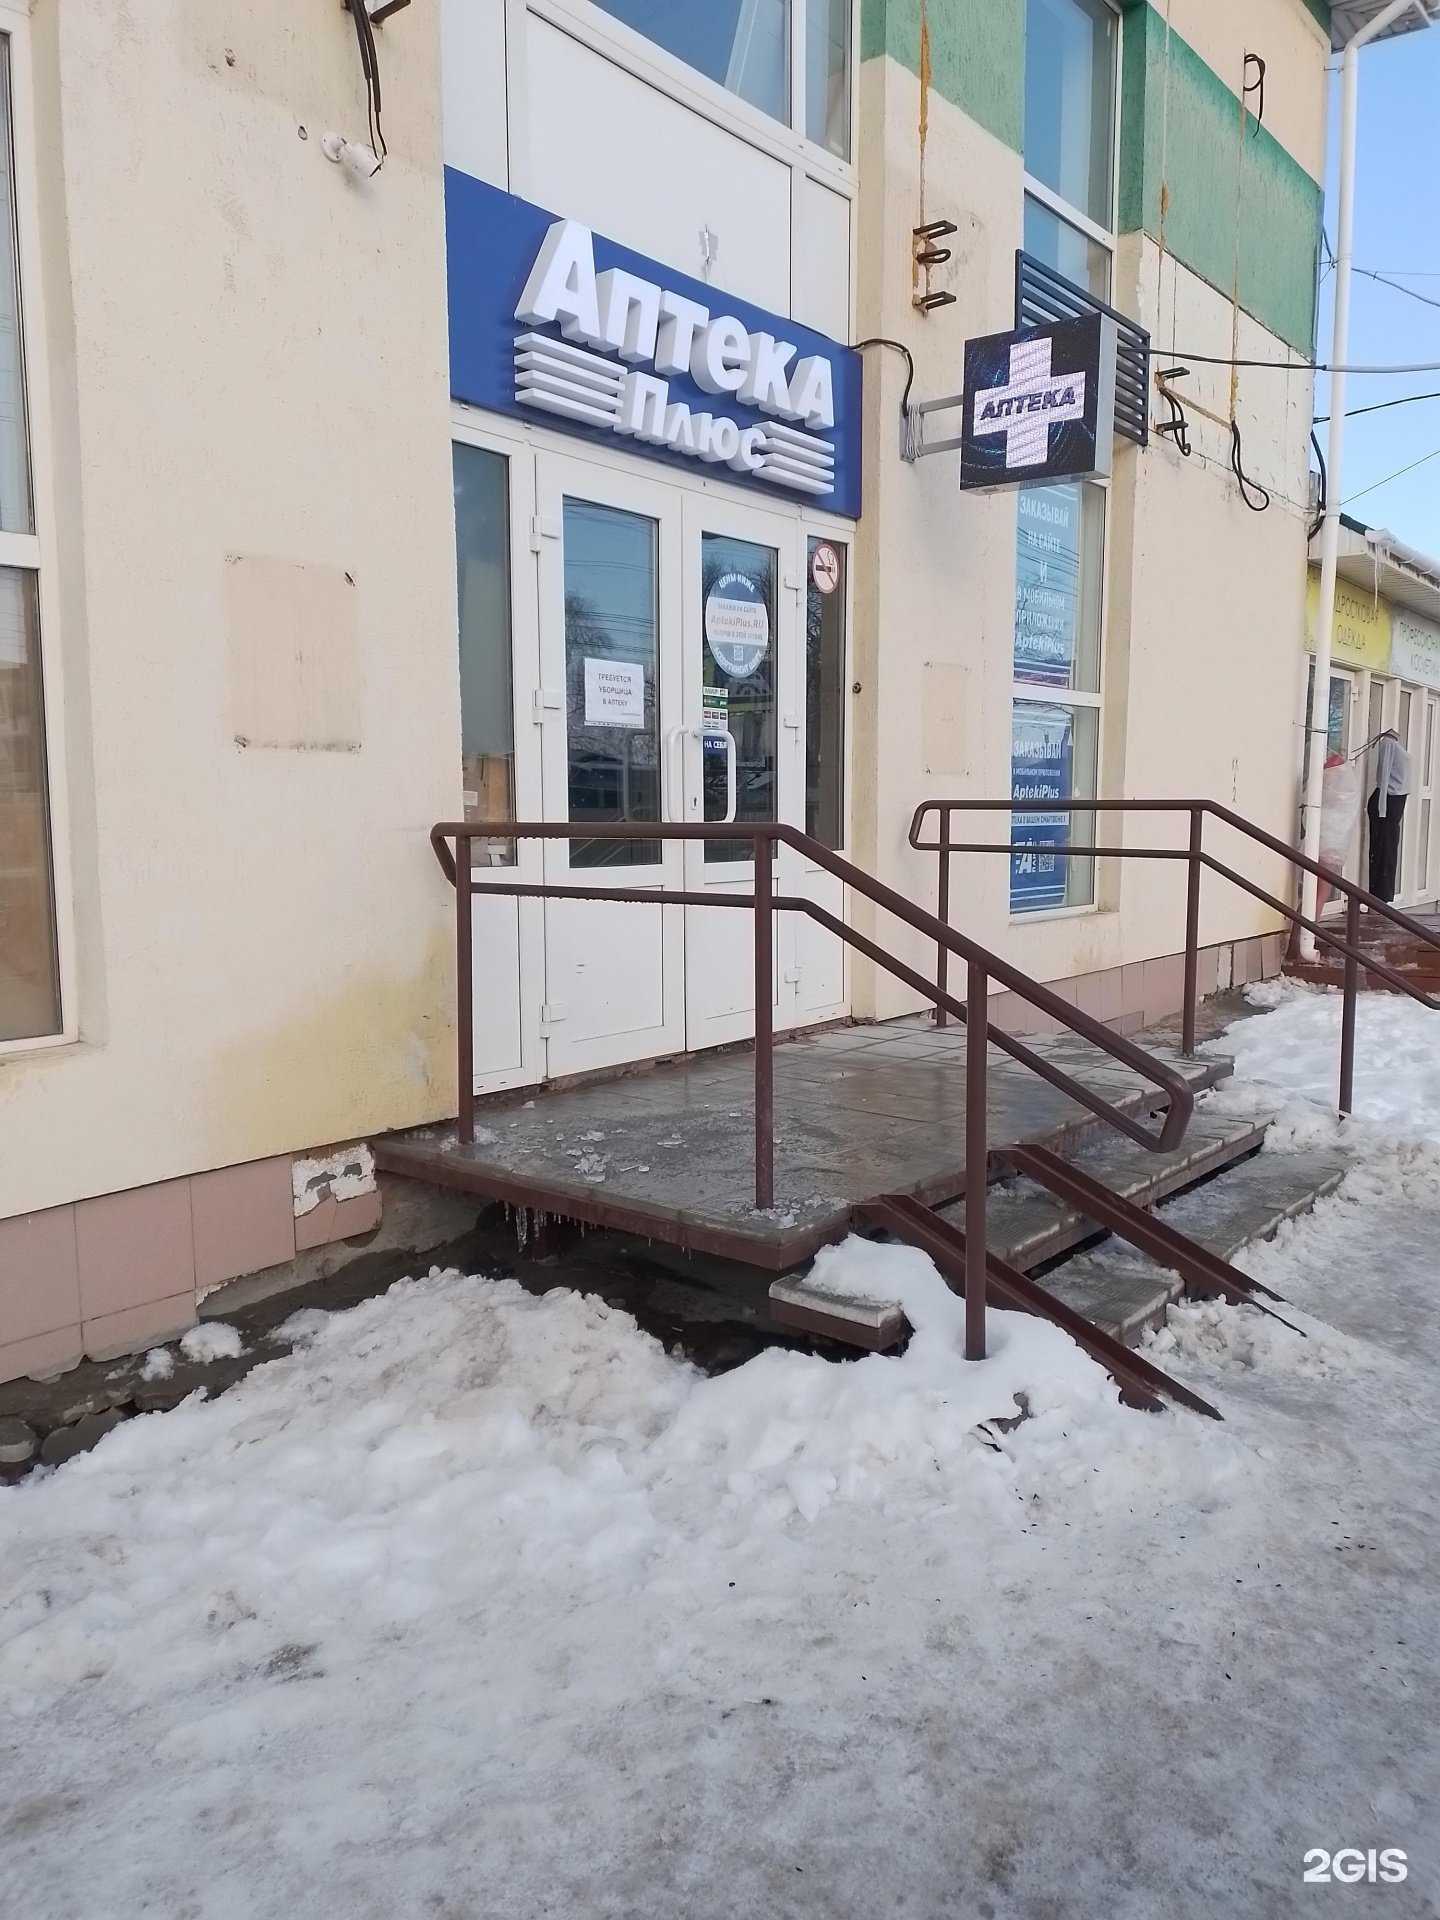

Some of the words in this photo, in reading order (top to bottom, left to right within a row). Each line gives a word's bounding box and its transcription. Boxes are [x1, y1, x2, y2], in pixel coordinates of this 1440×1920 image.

[979, 387, 1076, 421] АПТЕКА
[1020, 496, 1069, 528] ЗАКАЗЫВАЙ
[598, 672, 632, 684] ТРЕБУЕТСЯ
[598, 685, 633, 696] УБОРЩИЦА
[608, 698, 628, 706] АПТЕКУ
[704, 740, 713, 749] НА
[1013, 784, 1059, 800] AptekiPlus
